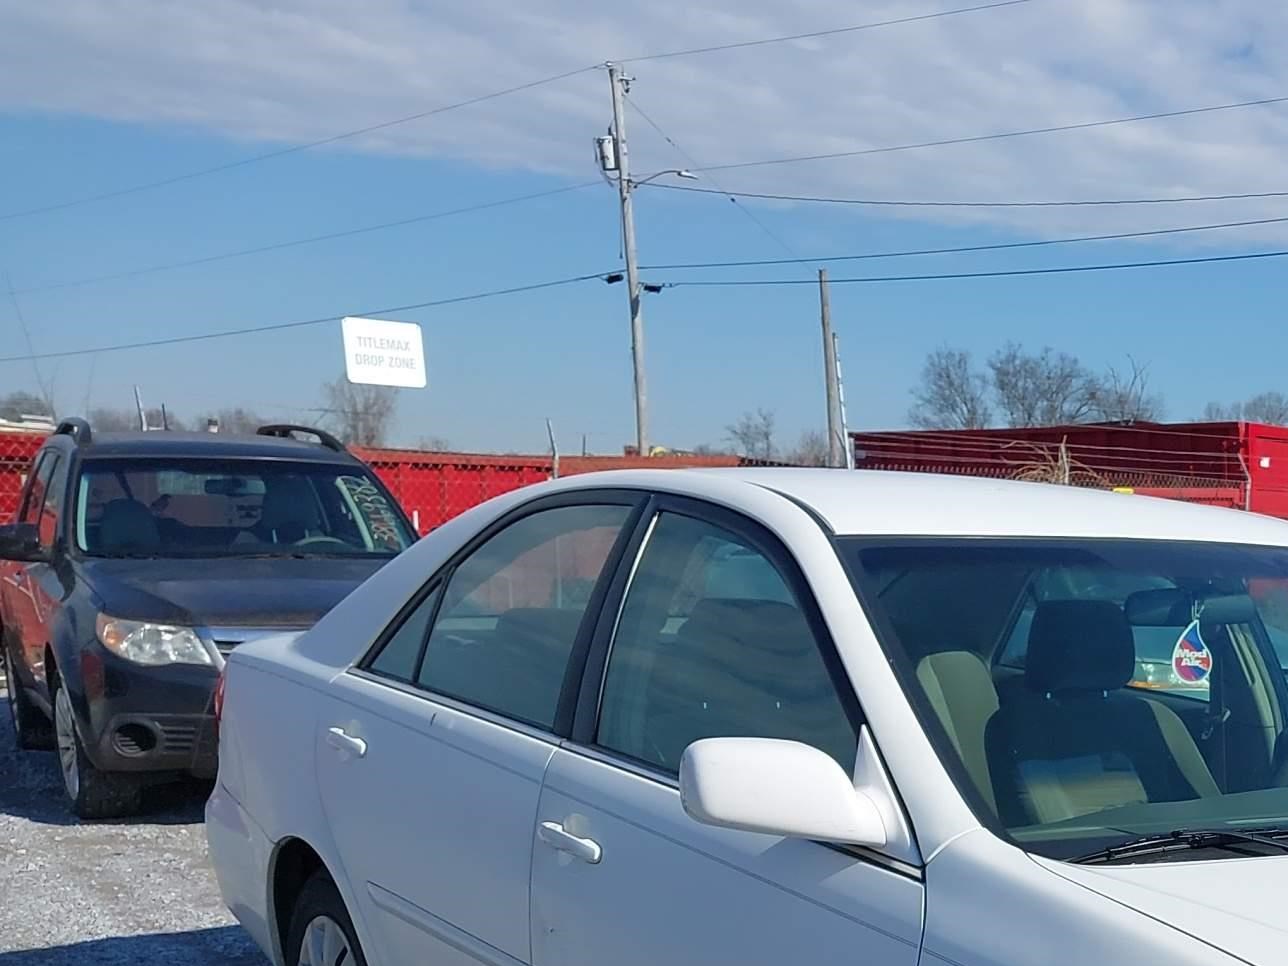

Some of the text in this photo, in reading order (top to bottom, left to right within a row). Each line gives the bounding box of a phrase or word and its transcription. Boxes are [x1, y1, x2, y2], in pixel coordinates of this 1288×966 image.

[355, 335, 411, 351] TITLEMAX
[354, 352, 417, 370] DROP ZONE
